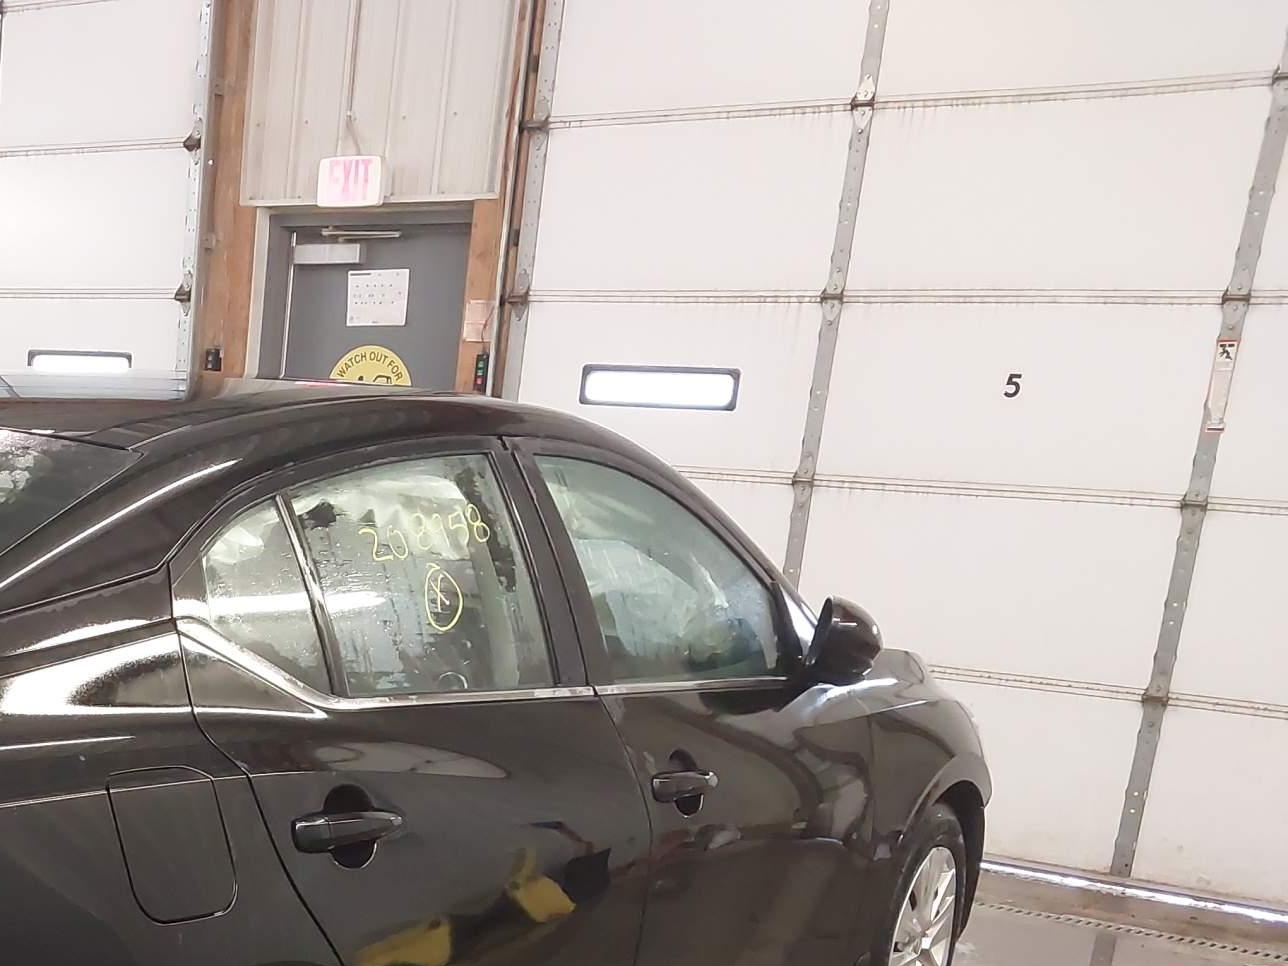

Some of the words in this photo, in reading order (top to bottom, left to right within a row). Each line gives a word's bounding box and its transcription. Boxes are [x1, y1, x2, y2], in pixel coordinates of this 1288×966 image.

[328, 159, 373, 200] EXIT
[336, 352, 367, 378] WATCH
[369, 351, 389, 364] OUT
[387, 360, 404, 382] FOR
[1003, 373, 1023, 398] 5
[358, 503, 491, 561] 208958
